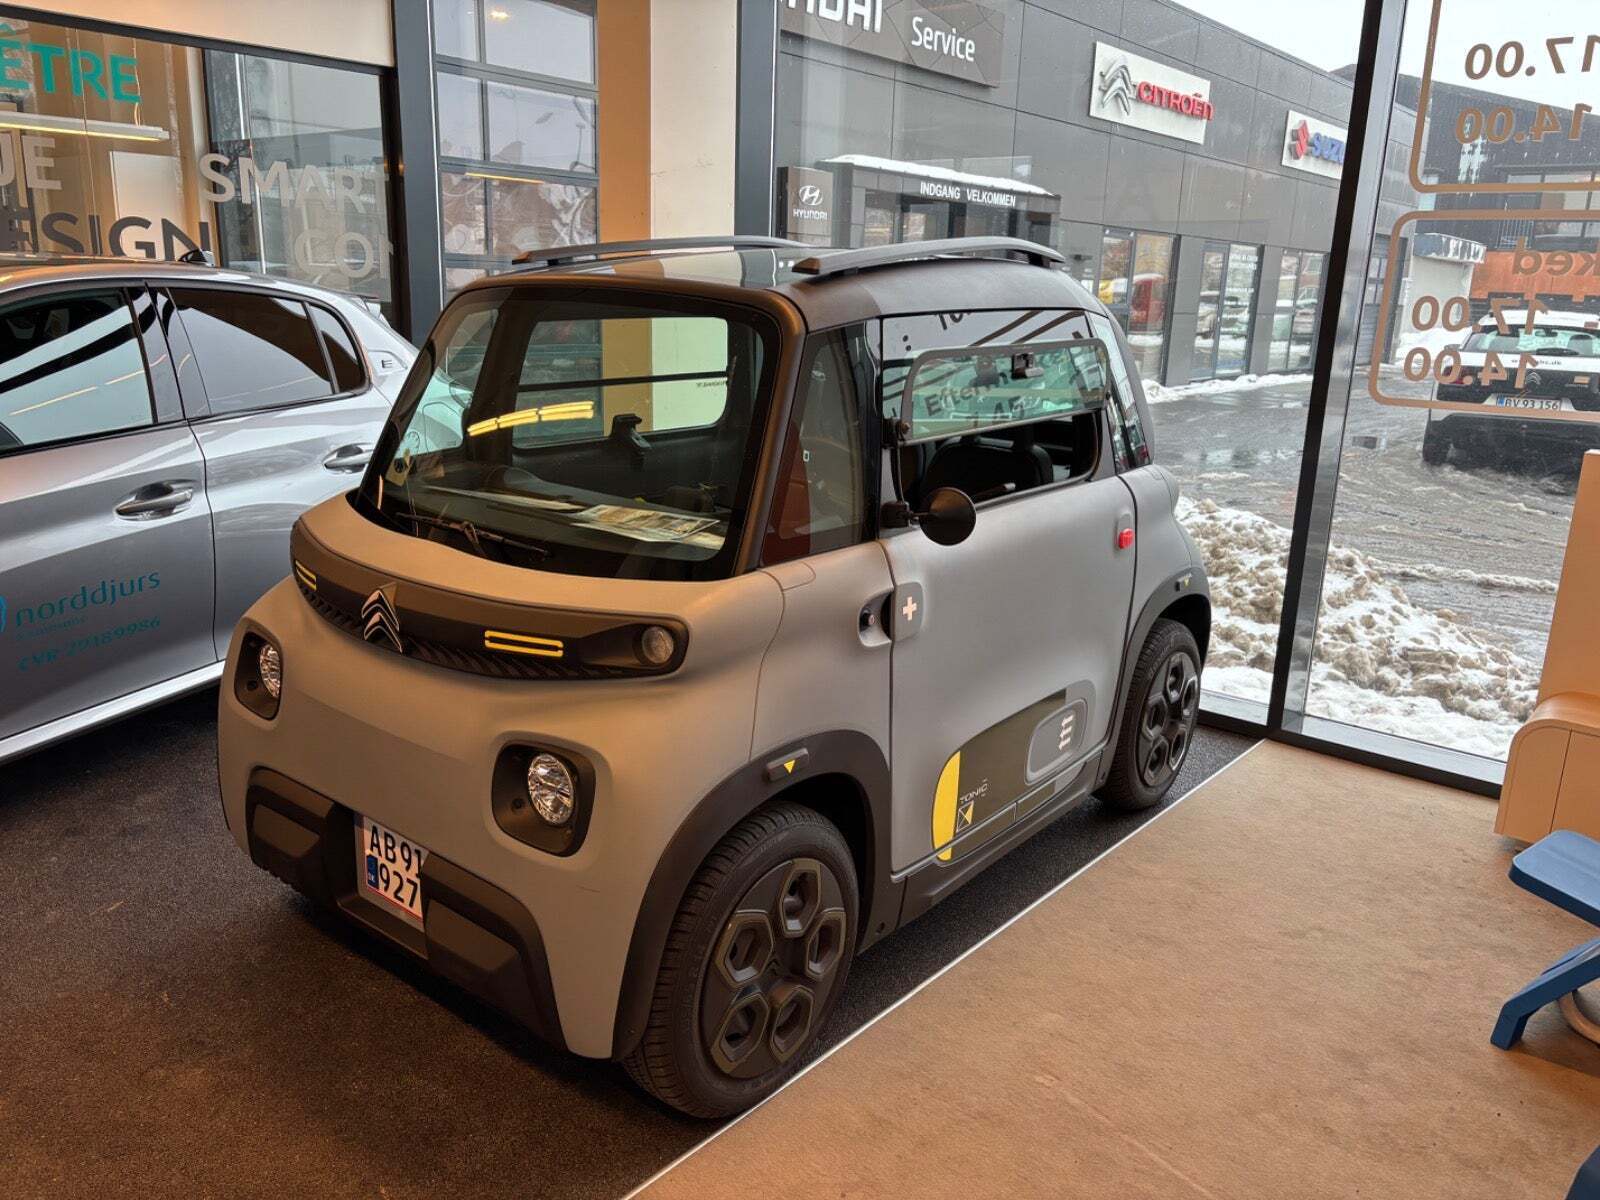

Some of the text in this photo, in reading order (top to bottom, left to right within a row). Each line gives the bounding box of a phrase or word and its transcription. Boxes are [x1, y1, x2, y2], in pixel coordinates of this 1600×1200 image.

[911, 16, 976, 62] Service
[200, 153, 390, 213] SMART
[920, 181, 1016, 207] INDGANG VELKOMMEN
[793, 208, 827, 221] HYUNDAI
[1522, 399, 1535, 408] 93
[1540, 400, 1558, 410] 156
[16, 571, 160, 627] norddjurs
[370, 825, 422, 879] AB91
[380, 863, 418, 908] 927
